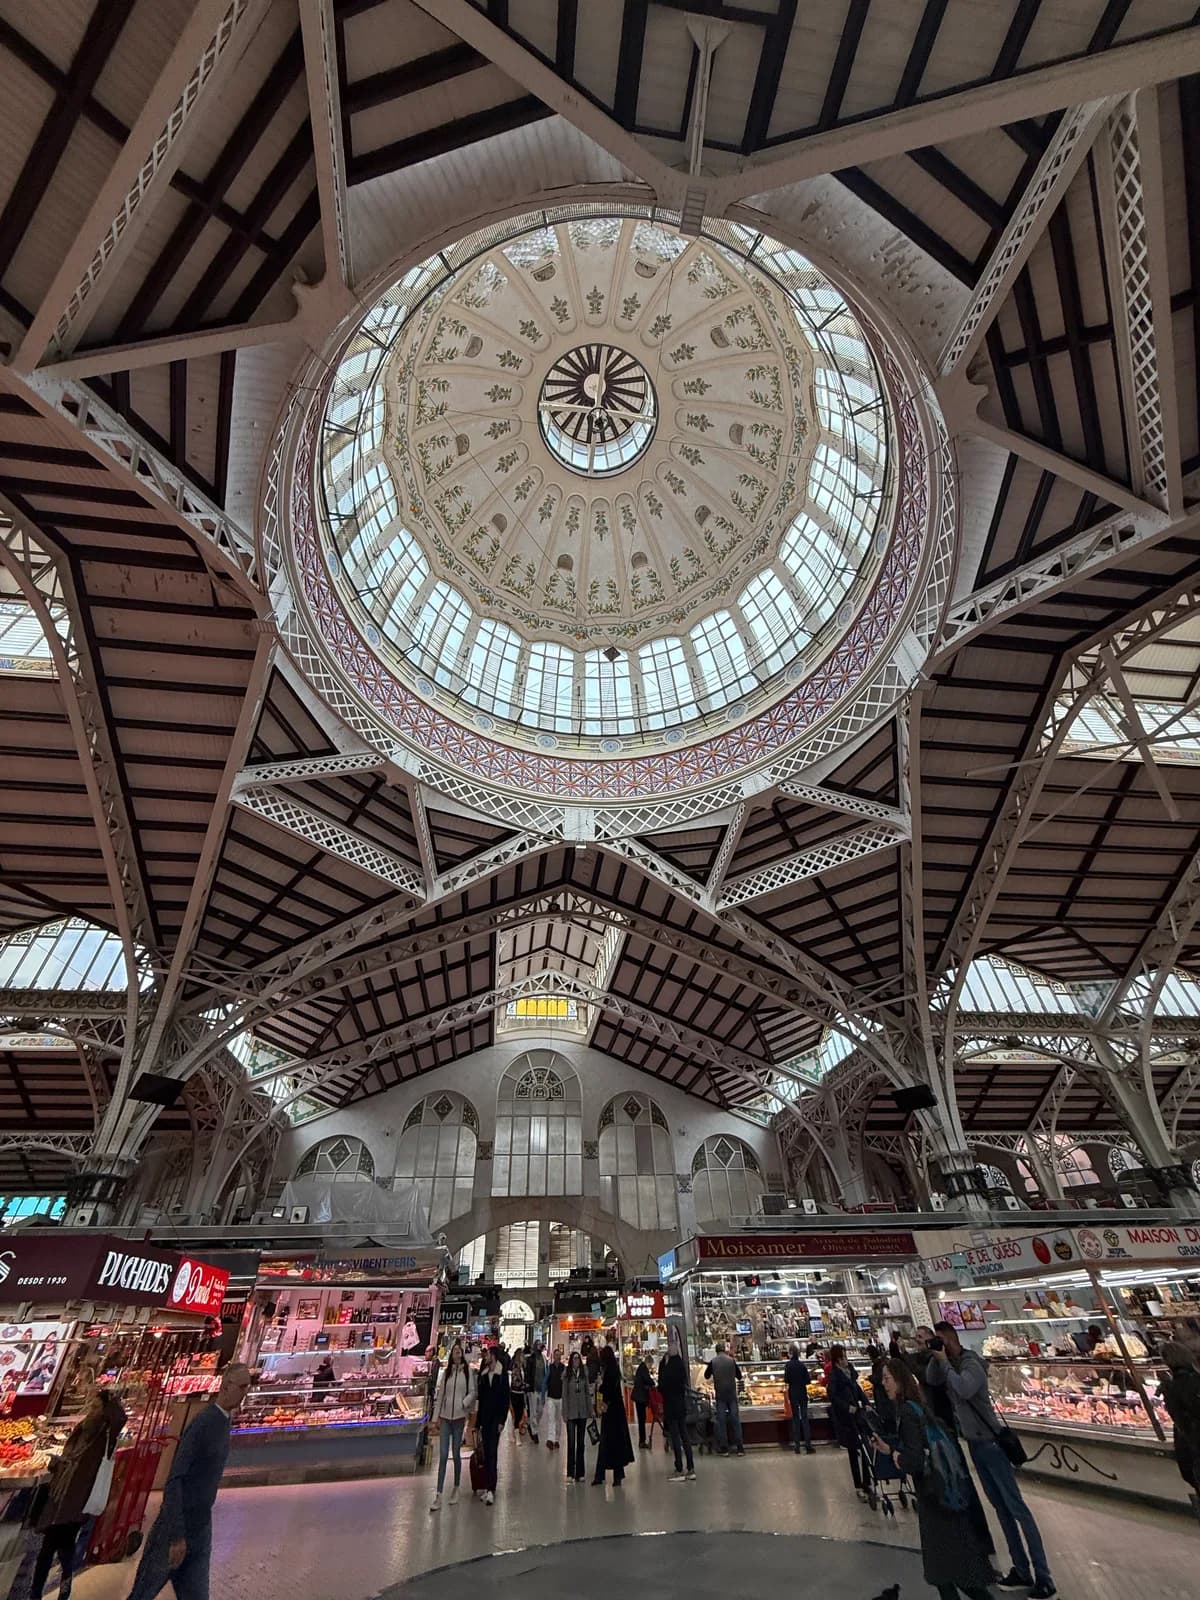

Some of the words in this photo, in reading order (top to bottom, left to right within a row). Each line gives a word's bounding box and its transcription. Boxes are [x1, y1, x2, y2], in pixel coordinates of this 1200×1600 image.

[1126, 1228, 1181, 1244] MAISON
[707, 1239, 806, 1256] Moixamer
[975, 1248, 993, 1263] DEL
[992, 1242, 1022, 1260] QUESO
[98, 1251, 172, 1293] PUCHADES
[17, 1277, 45, 1285] DESDE
[46, 1276, 67, 1285] 1930
[627, 1294, 655, 1307] Fruits
[630, 1306, 652, 1317] secs
